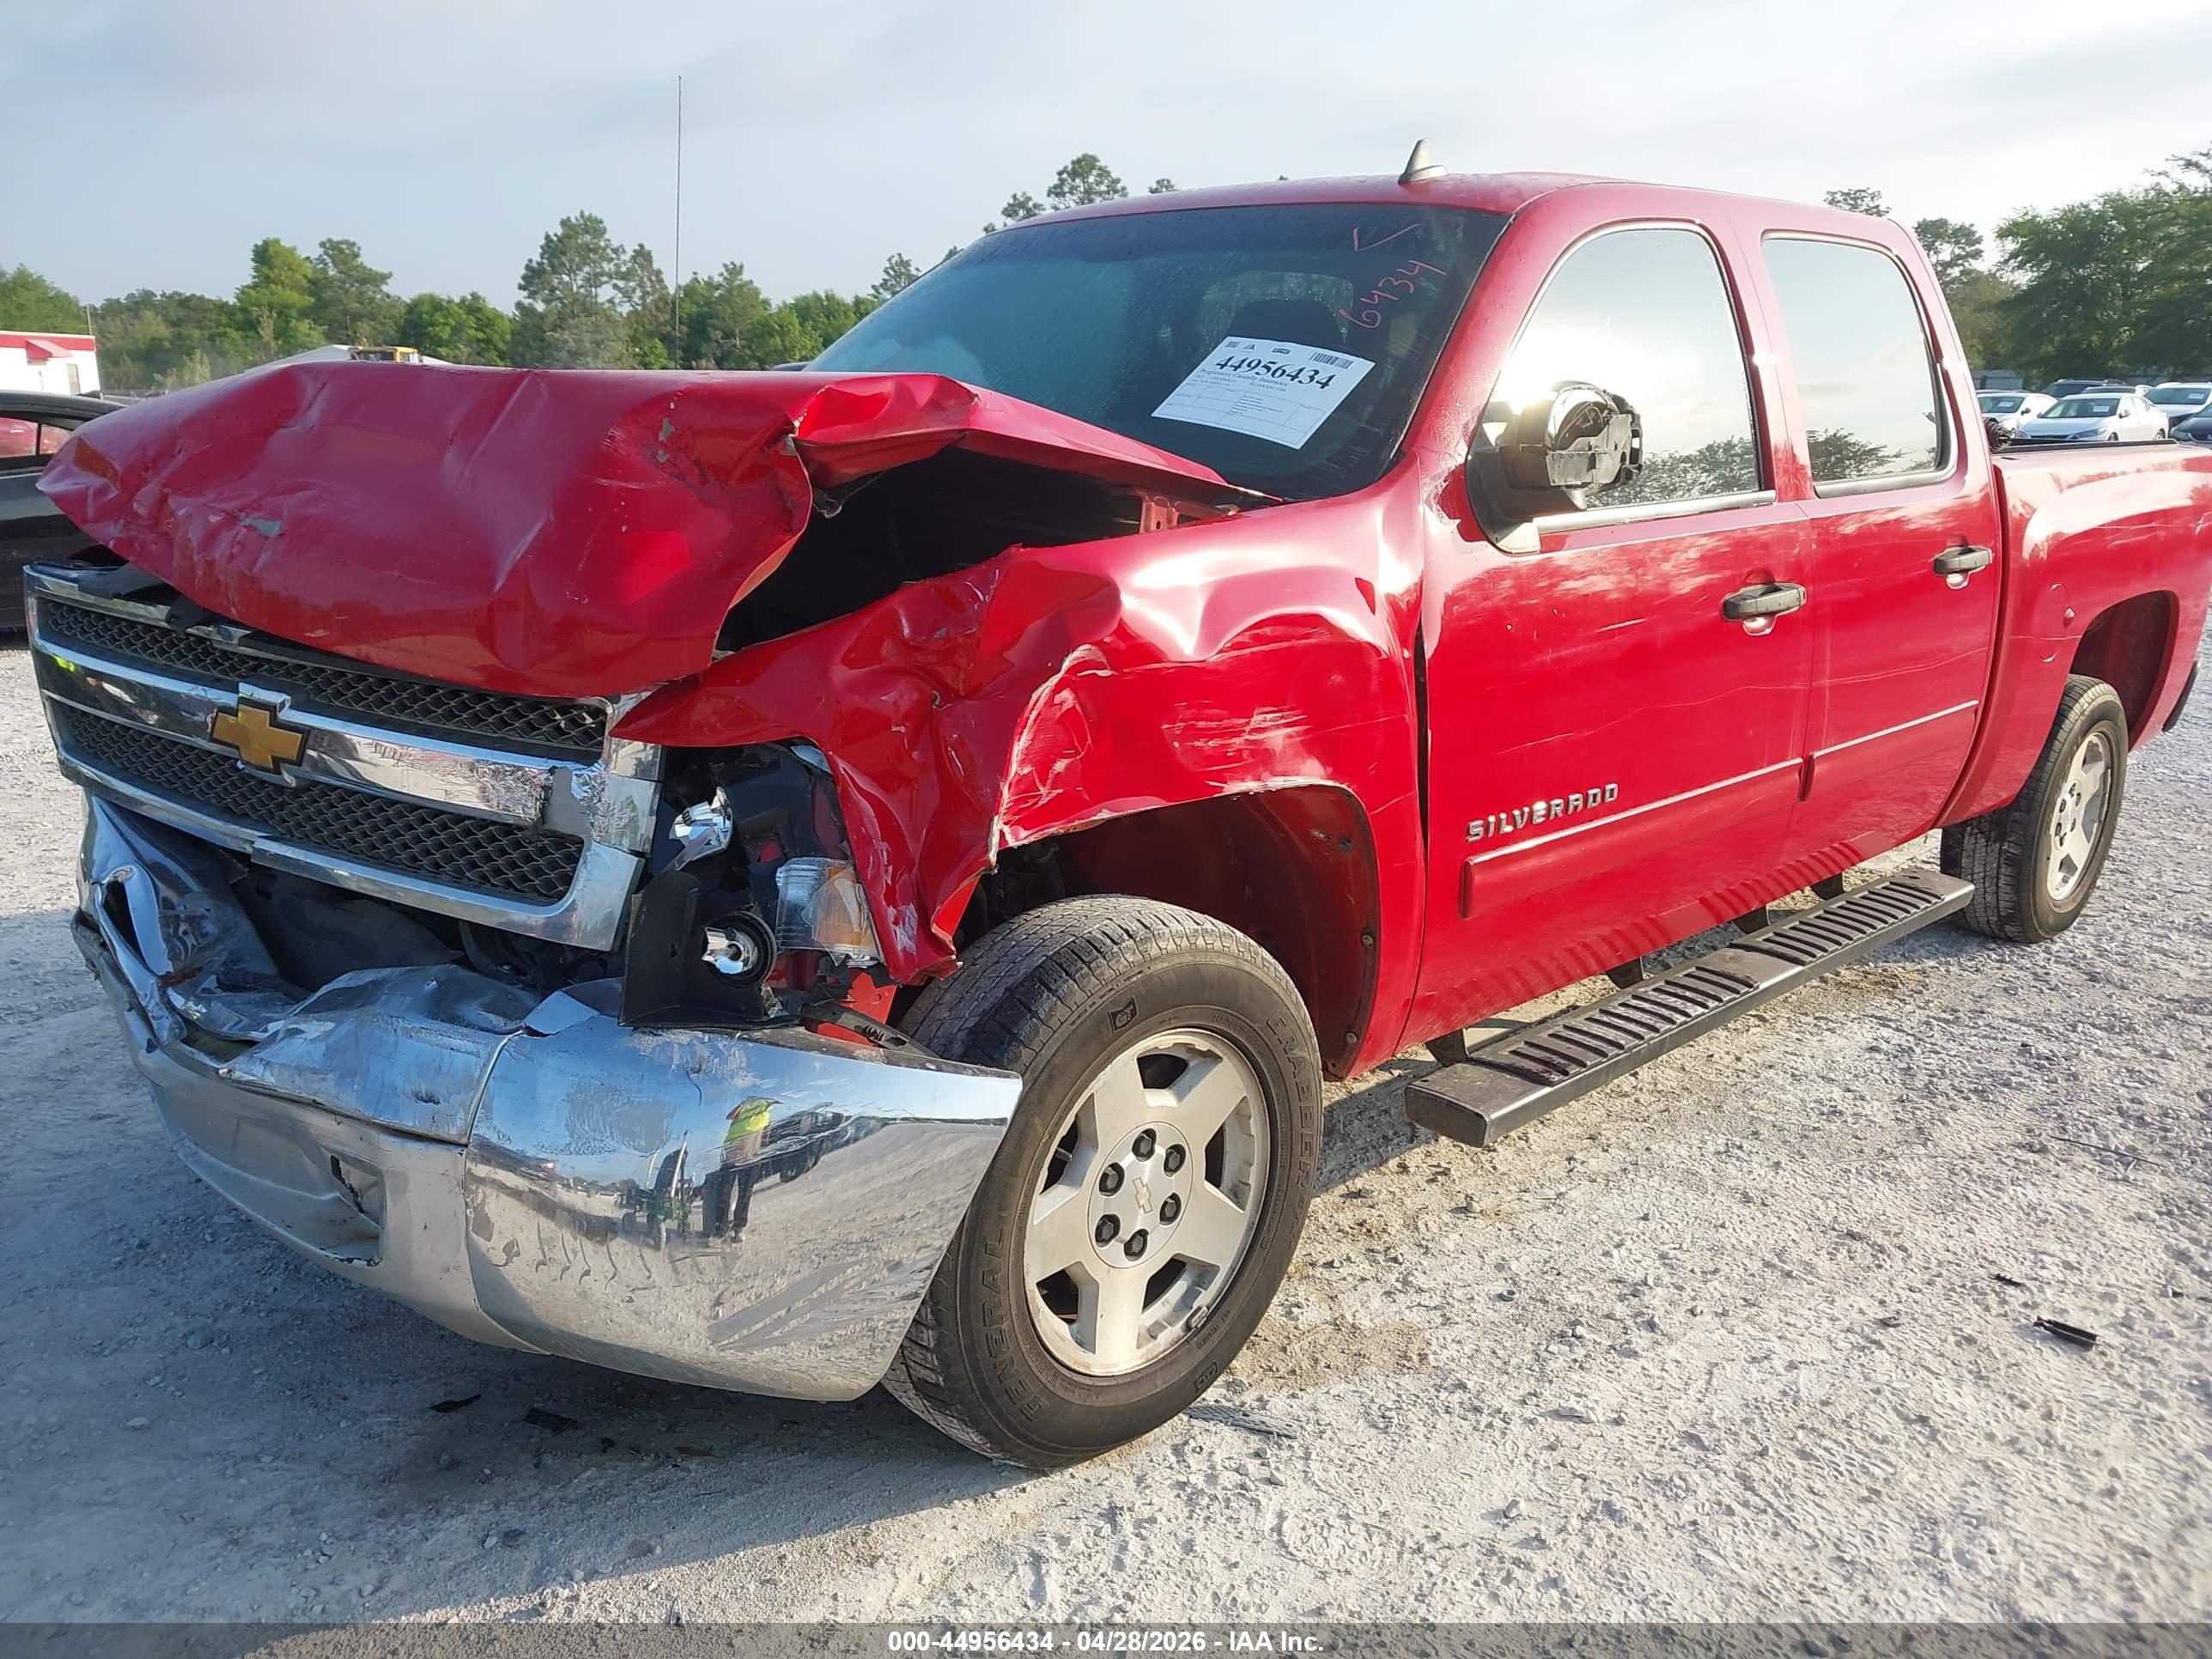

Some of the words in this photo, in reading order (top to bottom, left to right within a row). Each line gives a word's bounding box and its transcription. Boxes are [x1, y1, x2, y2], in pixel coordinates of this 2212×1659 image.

[1340, 259, 1447, 328] 6434
[1215, 355, 1336, 389] 44956434
[1465, 782, 1619, 842] SILVERADO
[981, 1227, 1050, 1422] GENERAL
